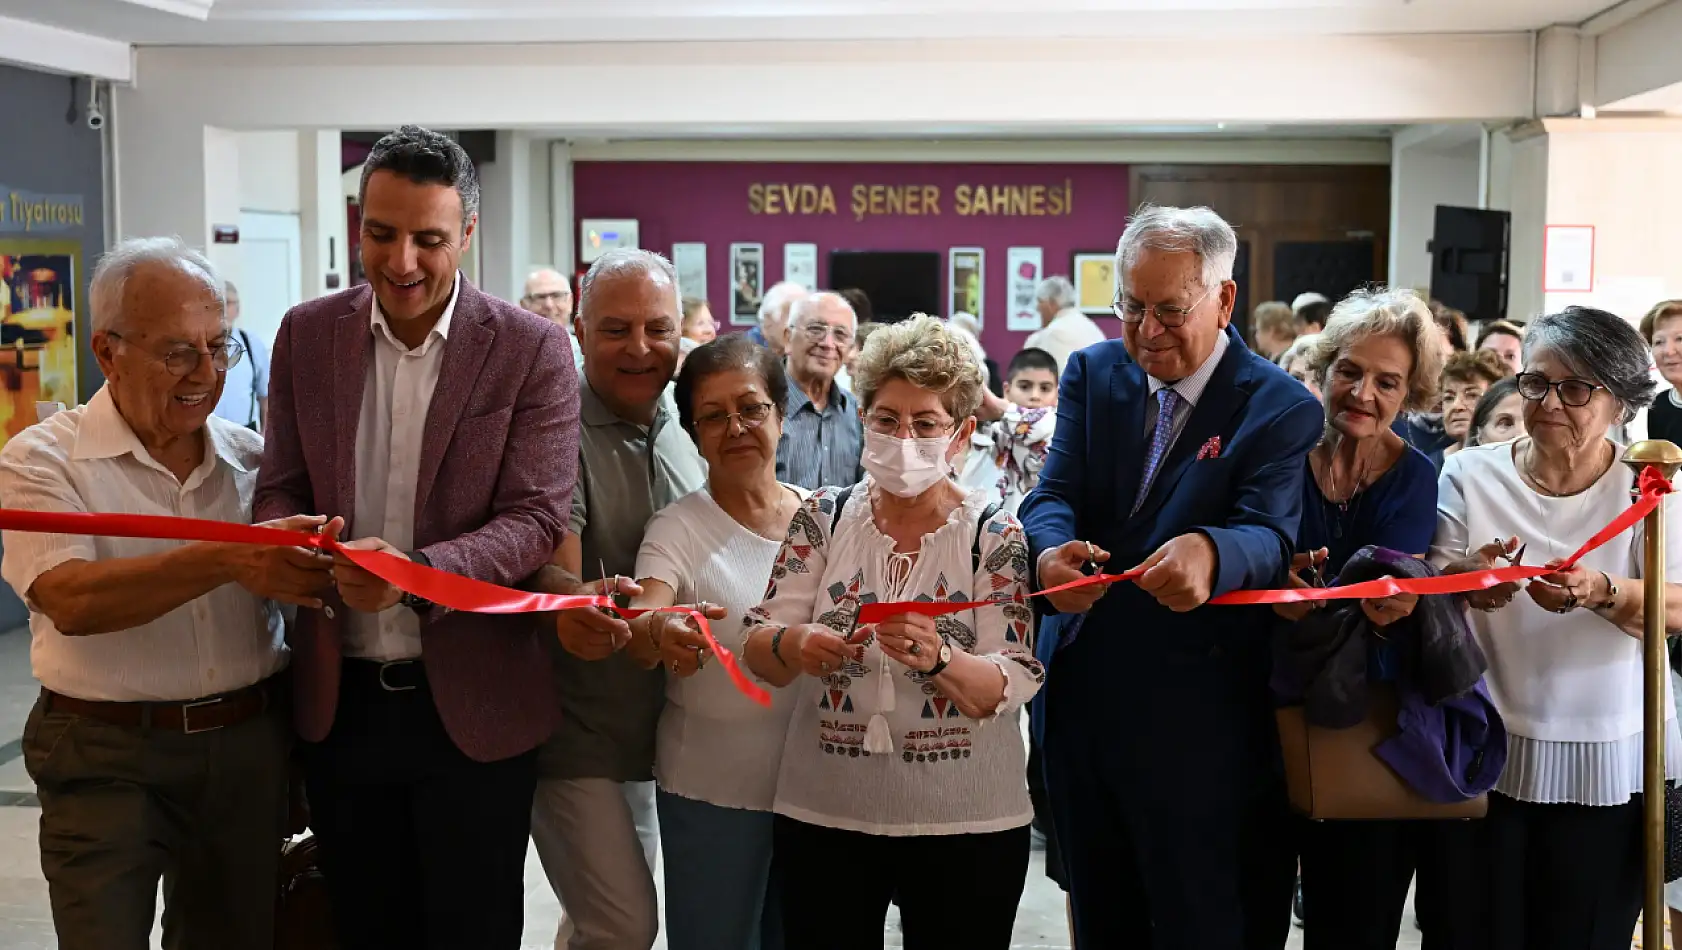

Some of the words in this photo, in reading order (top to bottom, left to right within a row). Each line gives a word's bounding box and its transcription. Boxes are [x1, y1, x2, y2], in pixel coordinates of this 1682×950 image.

[9, 192, 83, 231] Tiyatrosu
[748, 183, 836, 215] SEVDA
[851, 184, 940, 221] ŞENER
[955, 179, 1072, 215] SAHNESİ
